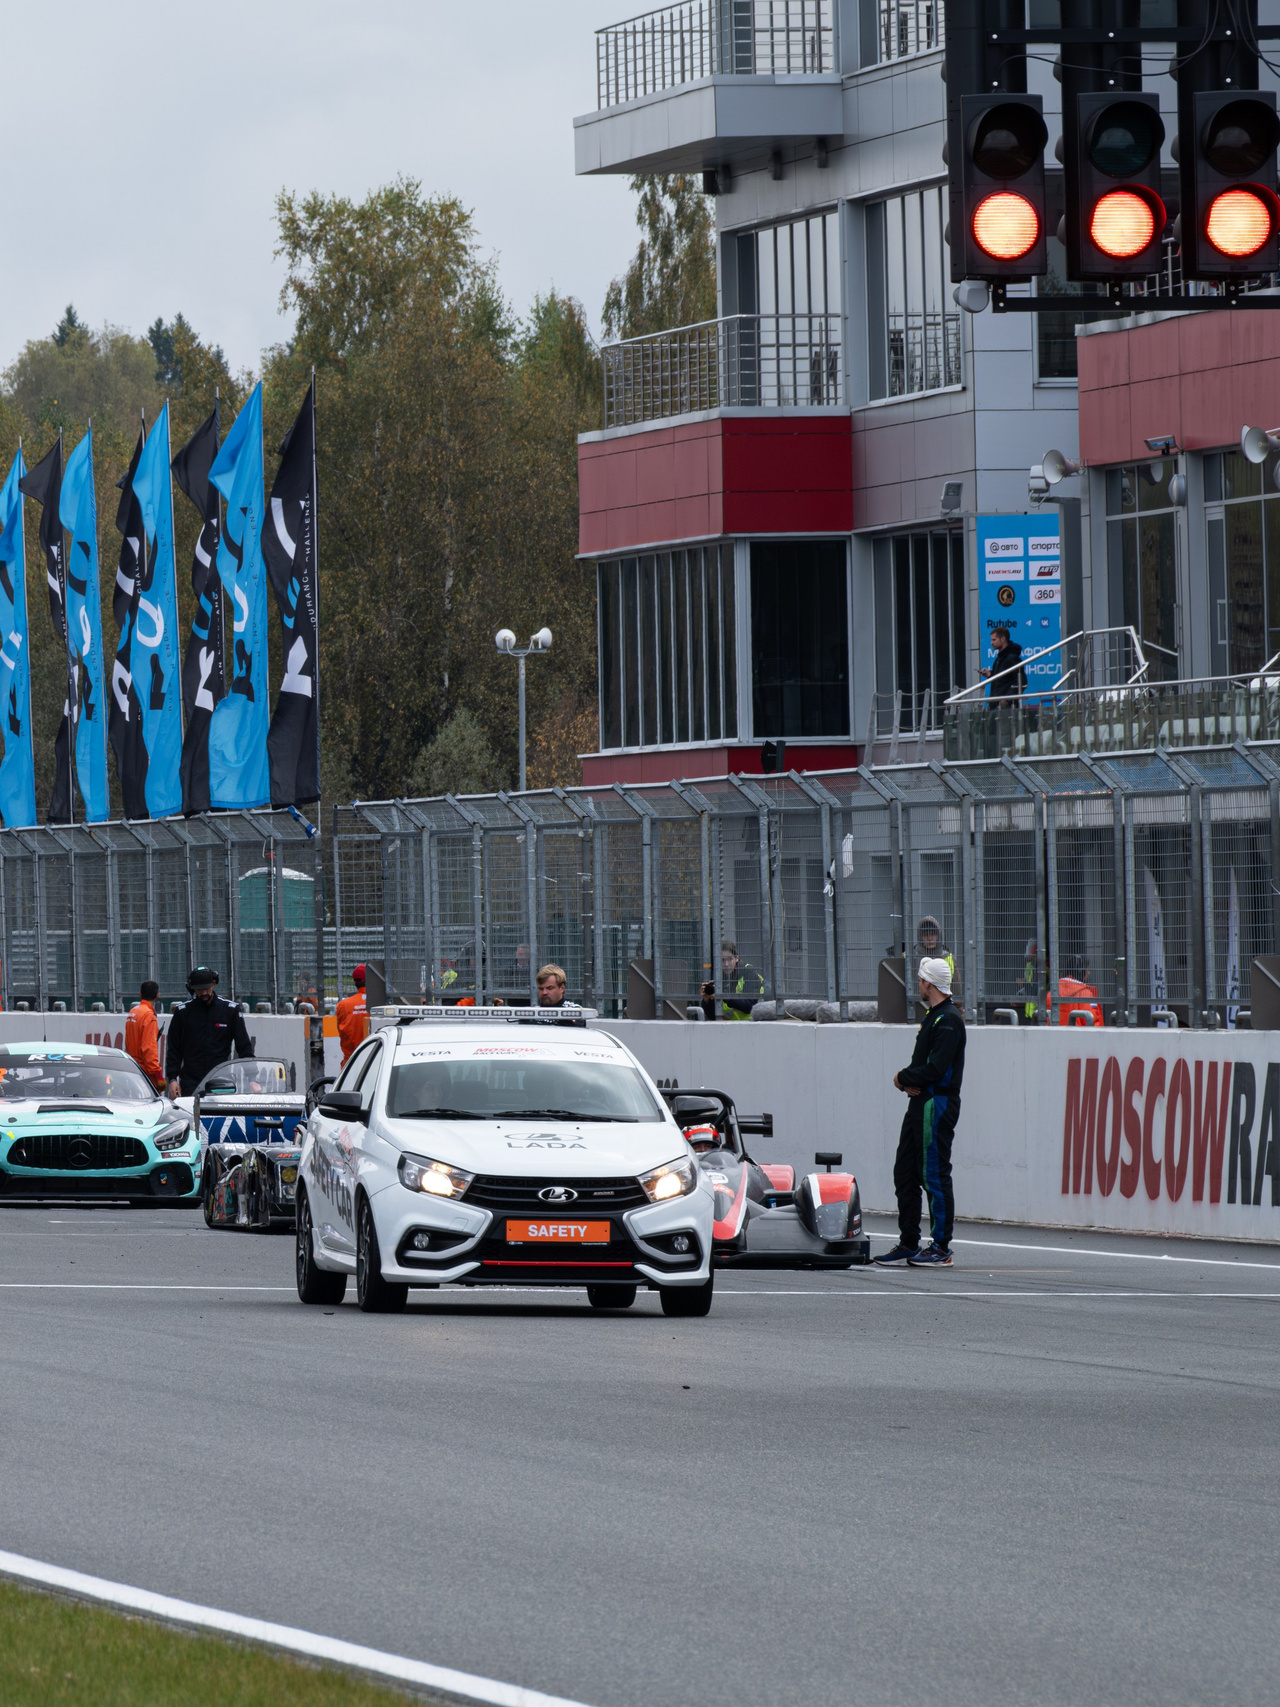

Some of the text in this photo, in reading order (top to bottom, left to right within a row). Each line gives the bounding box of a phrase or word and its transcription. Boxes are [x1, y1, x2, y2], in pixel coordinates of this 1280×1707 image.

[1037, 589, 1055, 600] 360
[987, 619, 1018, 629] Rutube
[573, 1051, 614, 1059] VESTA
[528, 1225, 588, 1238] SAFETY
